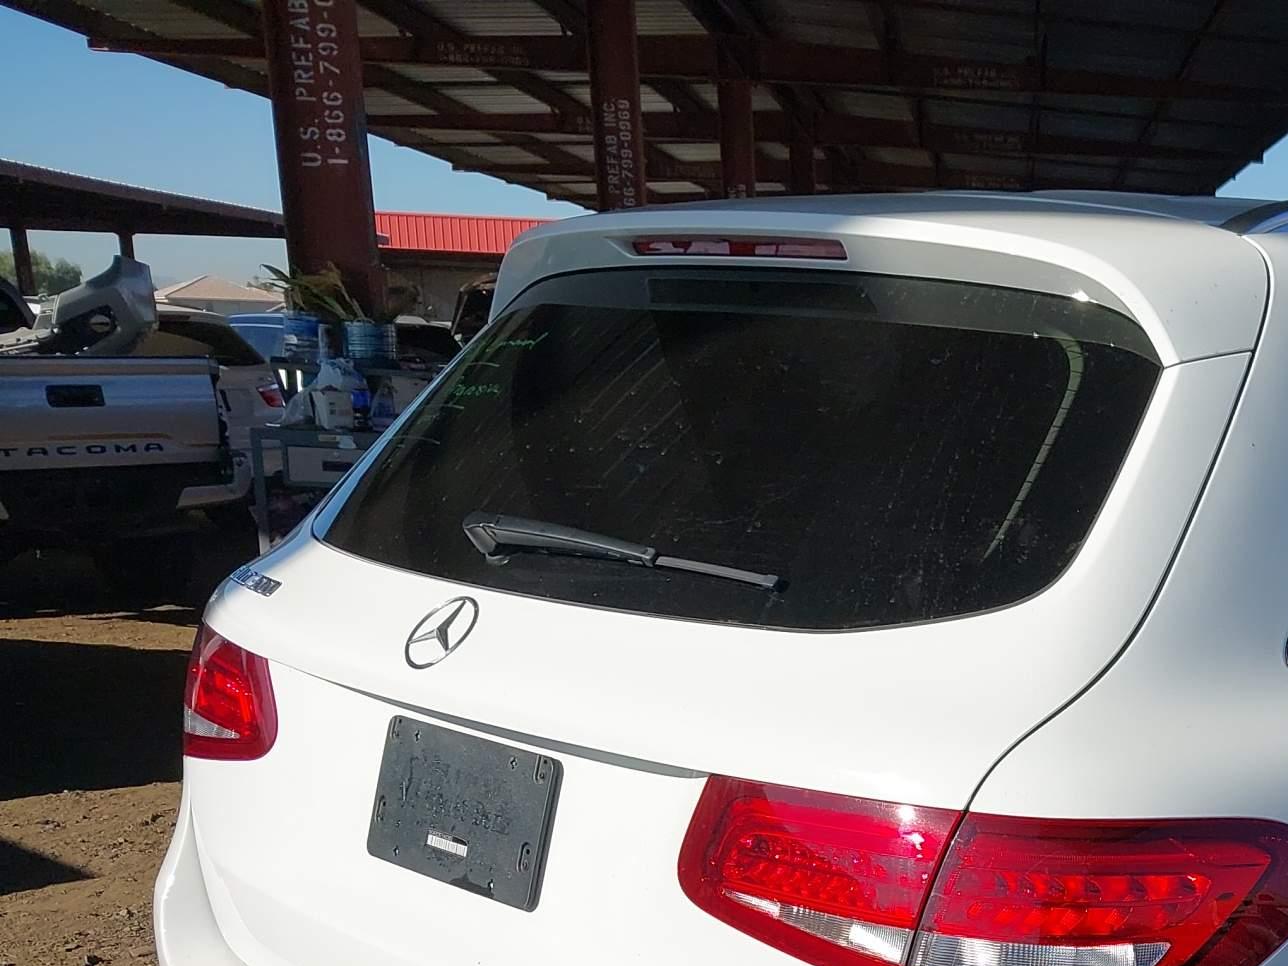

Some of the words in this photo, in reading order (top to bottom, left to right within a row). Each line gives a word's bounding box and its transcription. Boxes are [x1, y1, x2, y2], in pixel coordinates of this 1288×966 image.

[287, 0, 317, 101] PREFAB
[300, 119, 322, 167] U.S.
[605, 135, 621, 194] PREFAB
[0, 443, 164, 457] TACOMA
